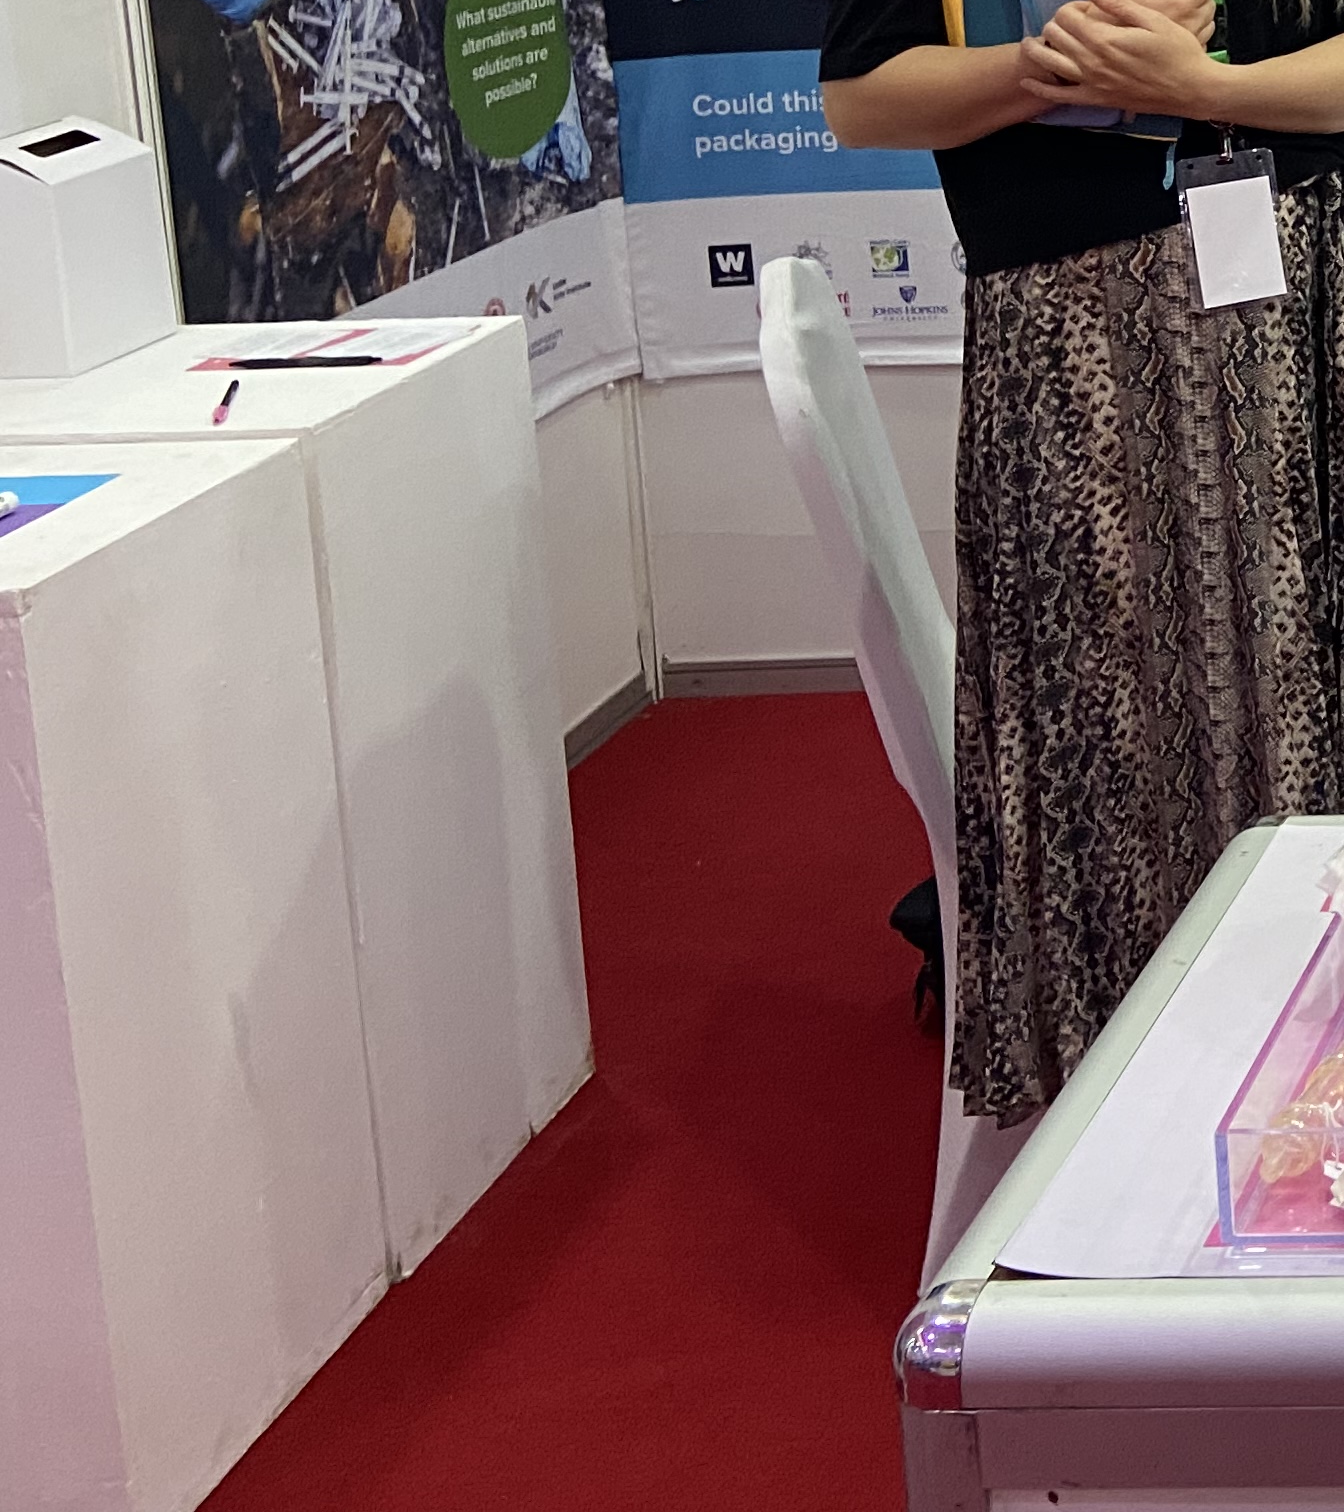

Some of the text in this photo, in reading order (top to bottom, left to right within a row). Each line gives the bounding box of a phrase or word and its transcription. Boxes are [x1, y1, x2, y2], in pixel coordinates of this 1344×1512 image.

[456, 8, 486, 29] What
[462, 16, 556, 57] alternatives and
[472, 48, 548, 82] solutions are
[485, 72, 538, 108] possible?
[692, 91, 774, 116] Could
[695, 126, 838, 159] packaging
[716, 251, 745, 273] W
[872, 306, 948, 318] JOHNS HOPKINS
